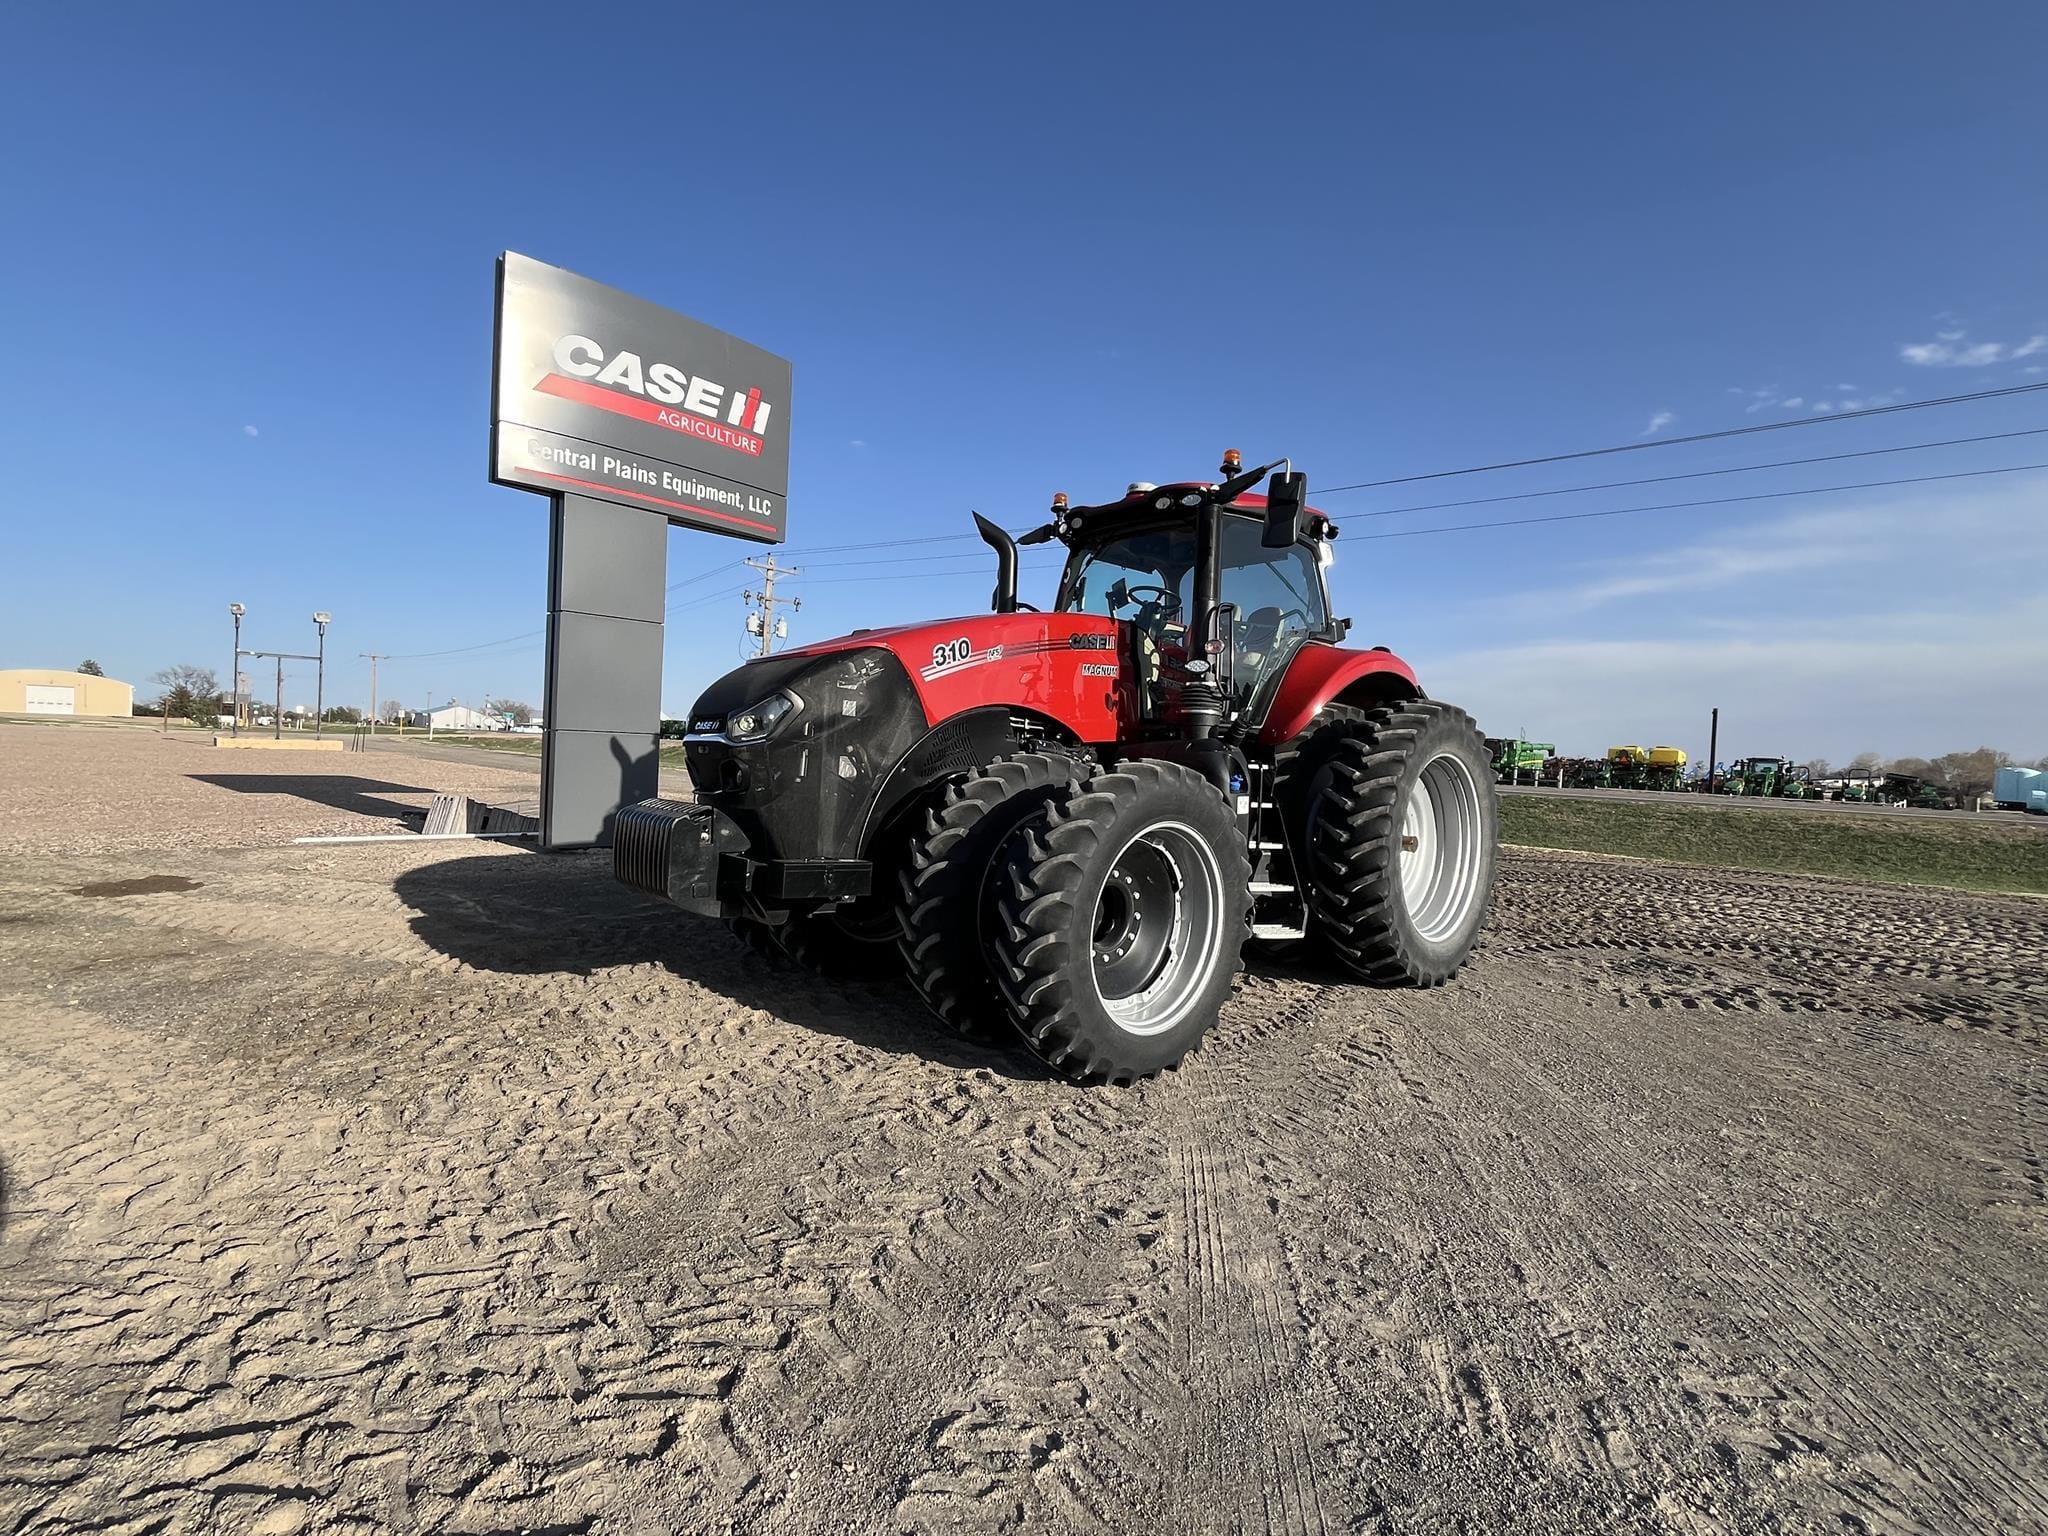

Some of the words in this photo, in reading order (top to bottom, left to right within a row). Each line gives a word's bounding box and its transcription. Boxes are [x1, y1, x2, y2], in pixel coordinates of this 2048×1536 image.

[553, 334, 725, 418] CASE
[657, 409, 758, 453] AGRICULTURE
[528, 439, 597, 471] Central
[603, 456, 658, 486] Plains
[662, 471, 745, 511] Equipment,
[748, 495, 772, 516] LLC
[934, 638, 971, 667] 310
[1070, 633, 1106, 650] CASE
[1083, 664, 1118, 677] MAGNUM
